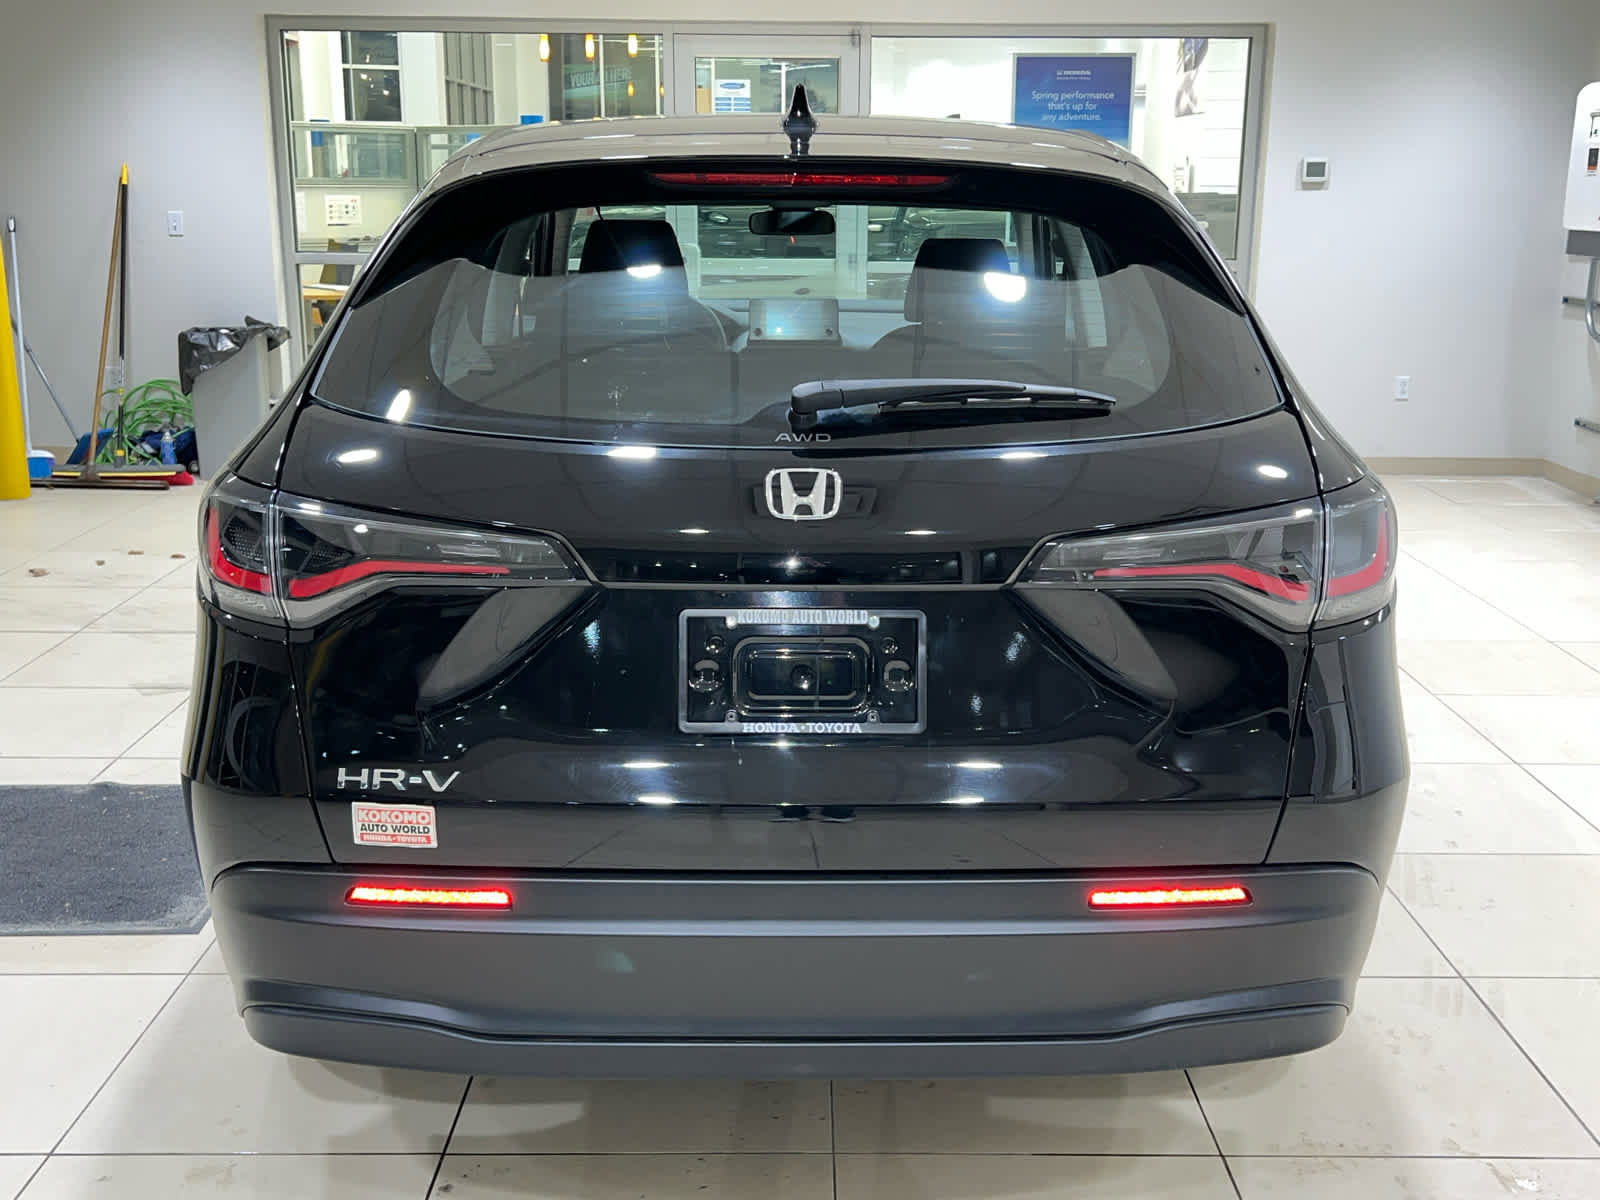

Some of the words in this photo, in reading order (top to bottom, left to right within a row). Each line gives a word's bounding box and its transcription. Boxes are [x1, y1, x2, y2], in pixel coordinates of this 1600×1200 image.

[1032, 90, 1059, 102] Spring
[1060, 90, 1115, 102] performance
[1047, 102, 1070, 111] that's
[1072, 104, 1083, 113] up
[1085, 102, 1097, 111] for
[1041, 113, 1056, 122] any
[1058, 112, 1102, 121] adventure.
[775, 433, 832, 442] AWD
[737, 609, 790, 624] KOKOMO
[791, 609, 822, 624] AUTO
[825, 609, 869, 624] WORLD
[337, 768, 460, 792] HR-V
[358, 808, 431, 825] KOKOMO
[360, 823, 388, 833] AUTO
[391, 824, 430, 835] WORLD
